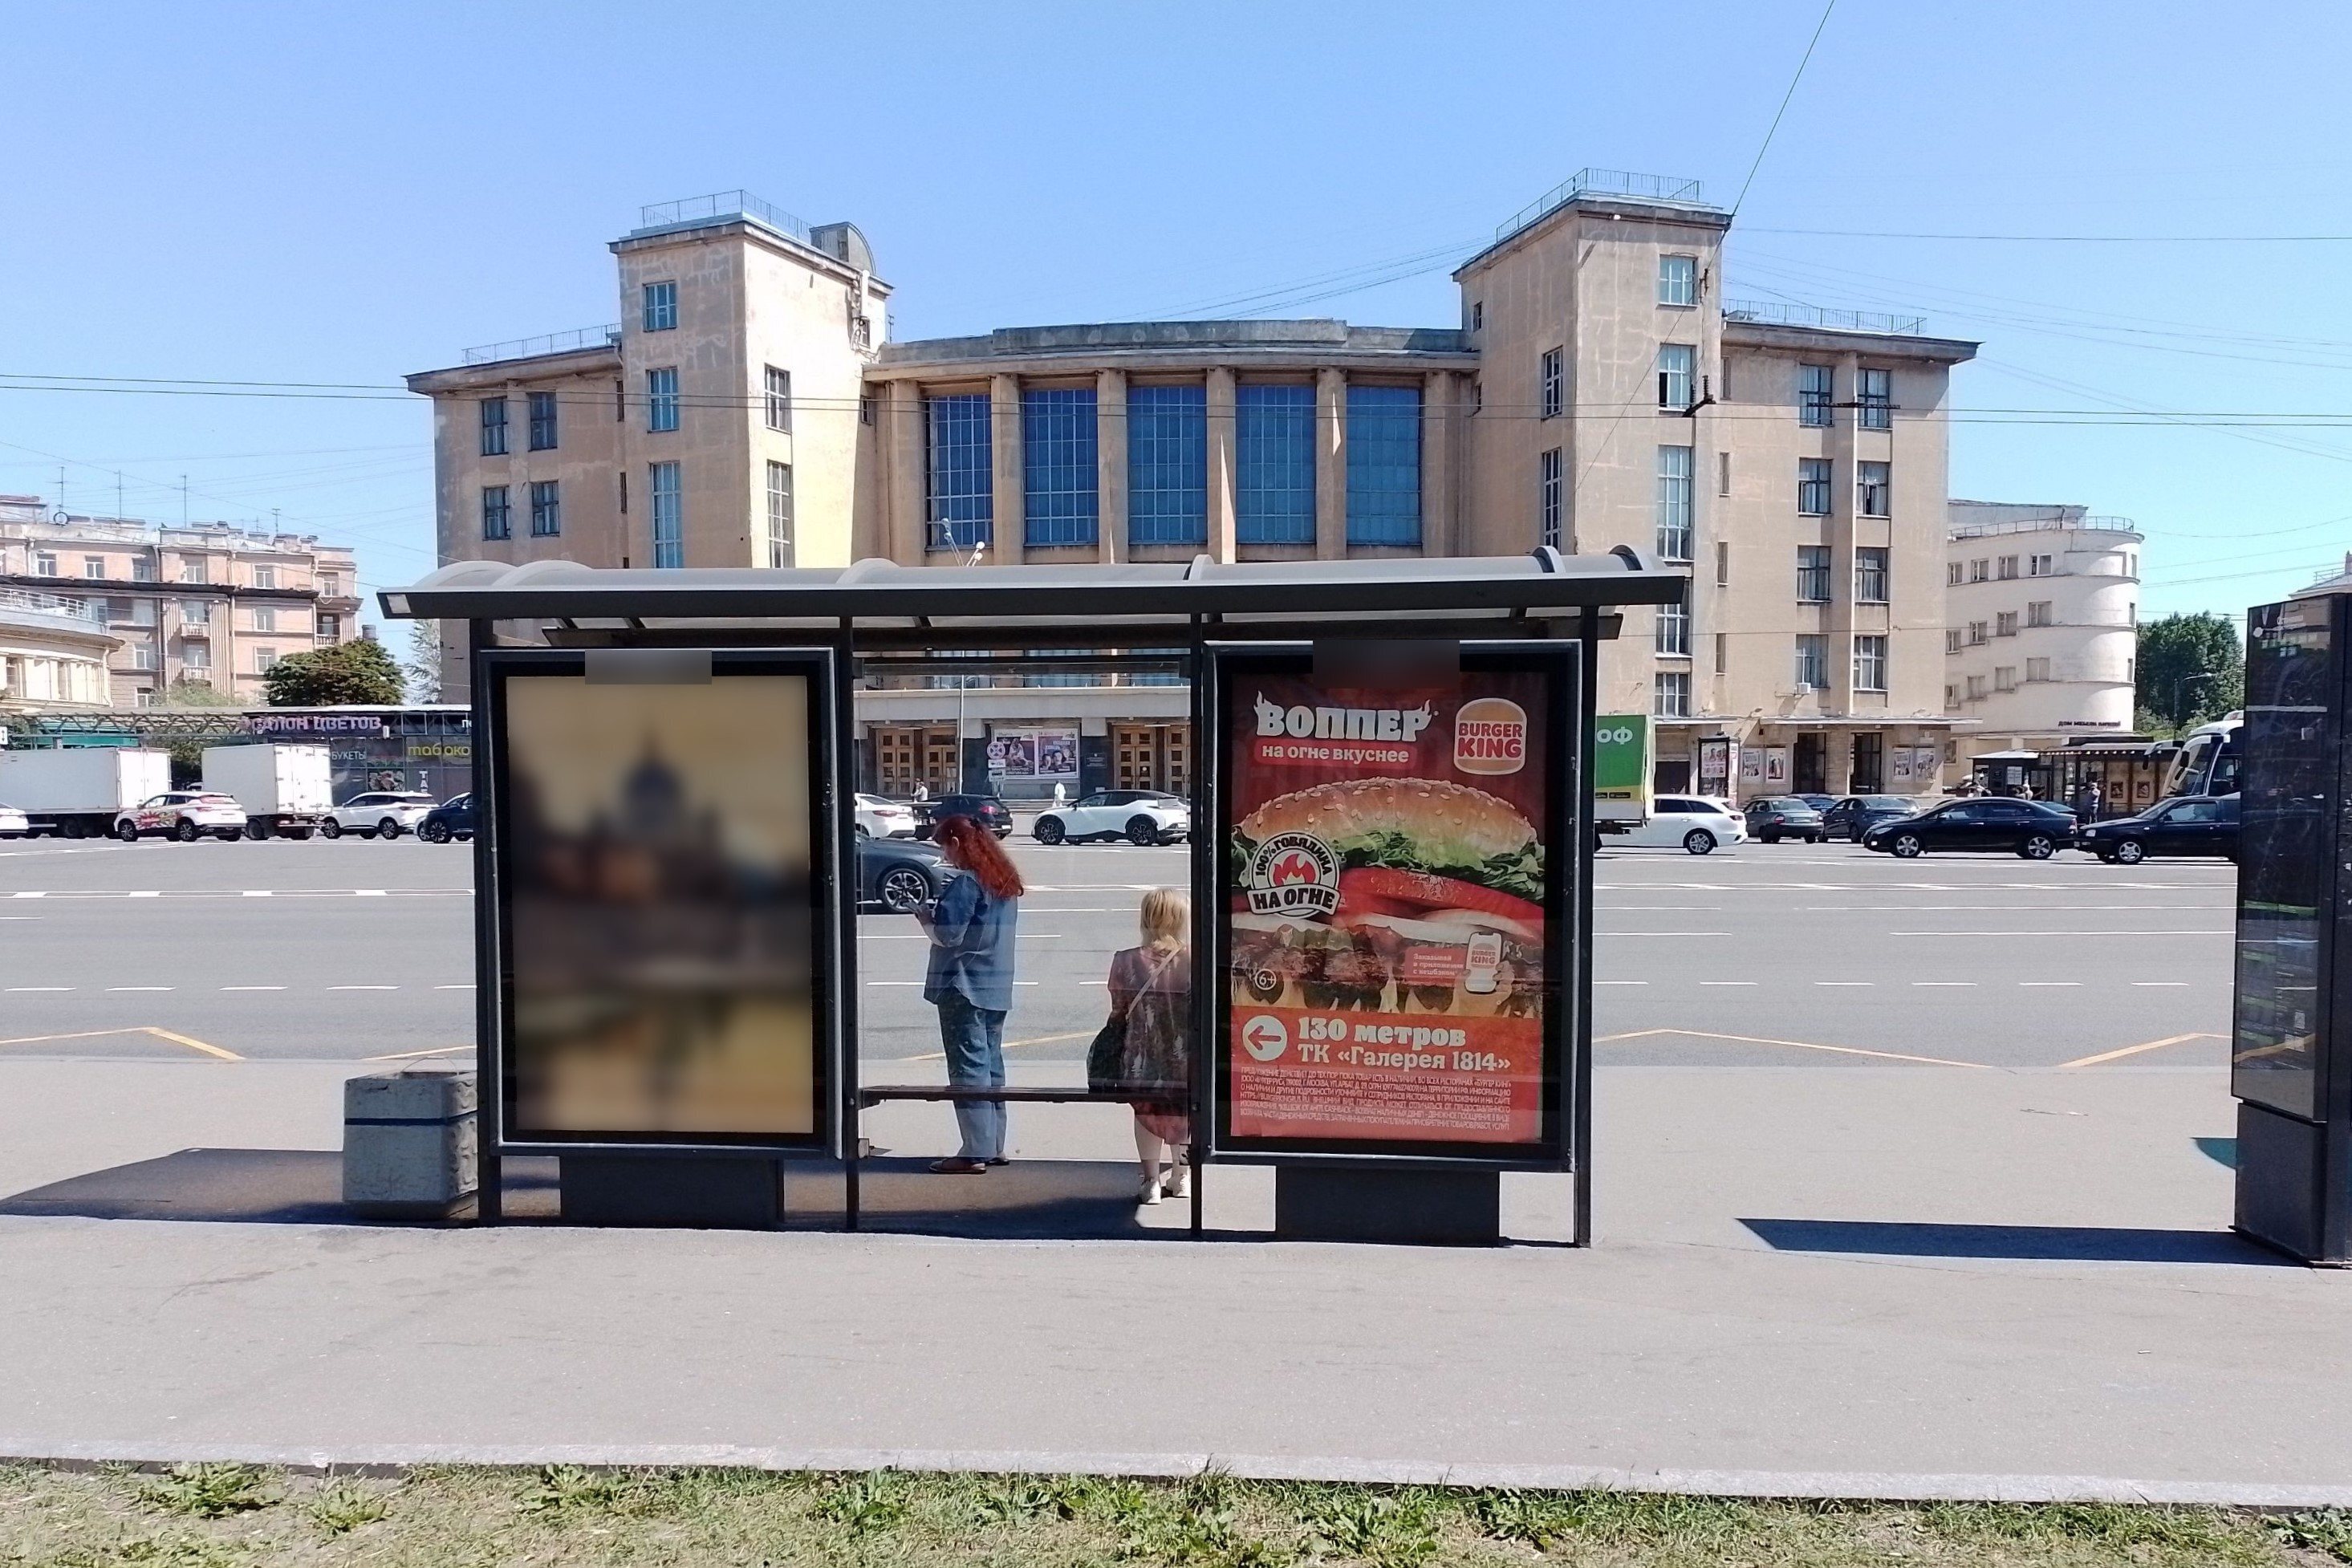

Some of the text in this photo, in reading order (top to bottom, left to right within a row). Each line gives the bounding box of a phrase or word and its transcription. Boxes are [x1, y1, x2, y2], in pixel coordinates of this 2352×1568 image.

[314, 716, 382, 731] ЦВЕТОВ
[1253, 690, 1432, 742] ВОППЕР
[1459, 723, 1522, 737] BURGER
[1262, 745, 1409, 764] на огне вкуснее
[1458, 737, 1521, 758] KING
[1273, 836, 1333, 875] ГОВЯДИНА
[1253, 888, 1335, 909] НА ОГНЕ
[1471, 955, 1497, 965] KING
[1259, 973, 1276, 985] 6+
[1298, 1017, 1466, 1051] 130 метров
[1298, 1043, 1511, 1072] ТК «Галерея 1814»
